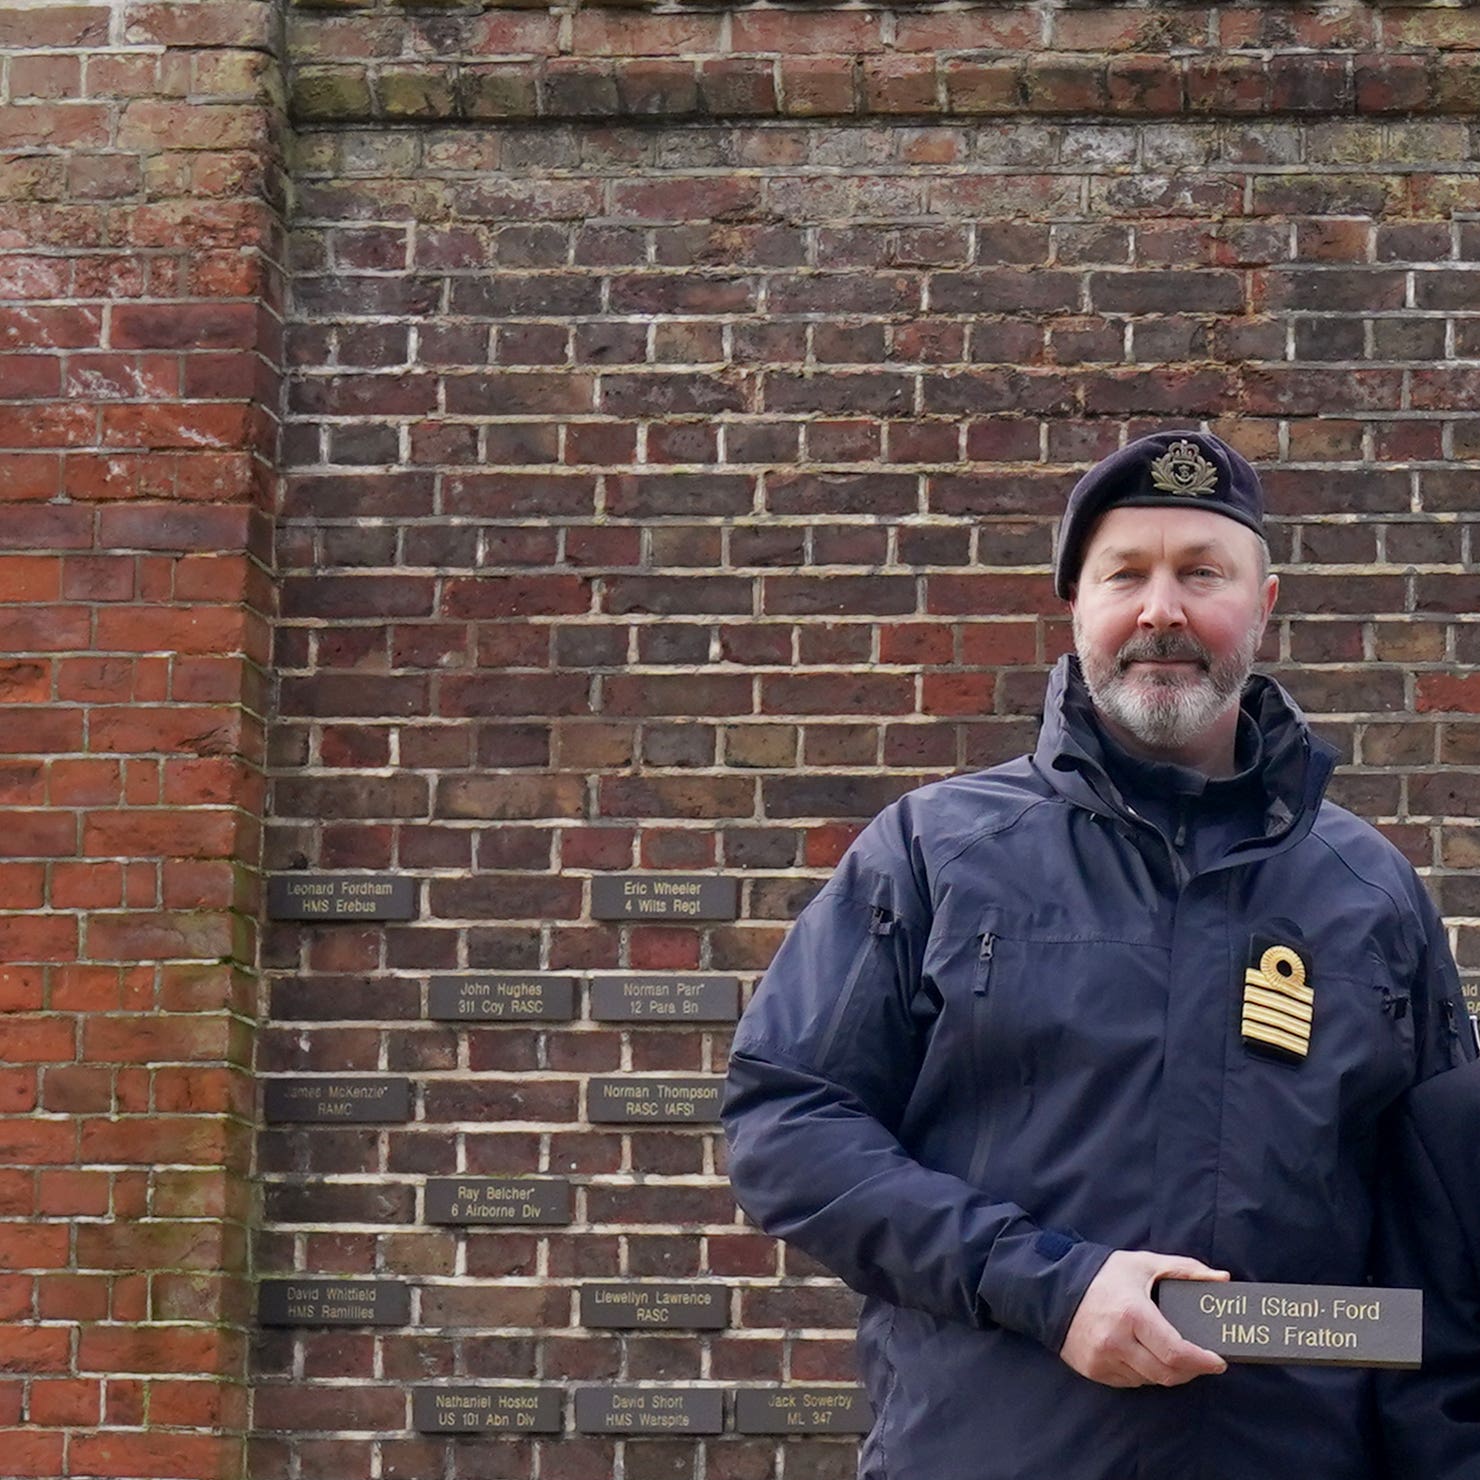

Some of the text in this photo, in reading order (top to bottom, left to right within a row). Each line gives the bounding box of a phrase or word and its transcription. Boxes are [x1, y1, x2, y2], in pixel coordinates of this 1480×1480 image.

[287, 882, 393, 895] Leonard Fordham
[624, 881, 702, 895] Eric Wheeler
[302, 899, 377, 913] HMS Erebus
[625, 899, 701, 915] 4 Wilts Regt
[460, 983, 543, 999] John Hughes
[623, 982, 670, 997] Norman
[458, 1000, 544, 1016] 311 Coy RASC
[630, 1001, 642, 1014] 12
[683, 1001, 699, 1014] Bn
[603, 1084, 718, 1101] Norman Thompson
[318, 1102, 353, 1116] RAMC
[626, 1103, 658, 1116] RASC
[457, 1185, 480, 1201] Ray
[451, 1204, 542, 1217] 6 Airborne Div
[287, 1287, 319, 1301] David
[595, 1290, 712, 1306] Llewellyn Lawrence
[287, 1305, 315, 1318] HMS
[636, 1308, 669, 1322] RASC
[1200, 1294, 1247, 1318] Cyril
[1333, 1299, 1382, 1321] Ford
[1221, 1323, 1358, 1348] HMS Fratton
[435, 1394, 491, 1409] Nathaniel
[612, 1394, 683, 1409] David Short
[767, 1393, 853, 1410] Jack Sowerby
[439, 1412, 536, 1426] US 101 Abn Div
[605, 1412, 690, 1428] HMS Warspite
